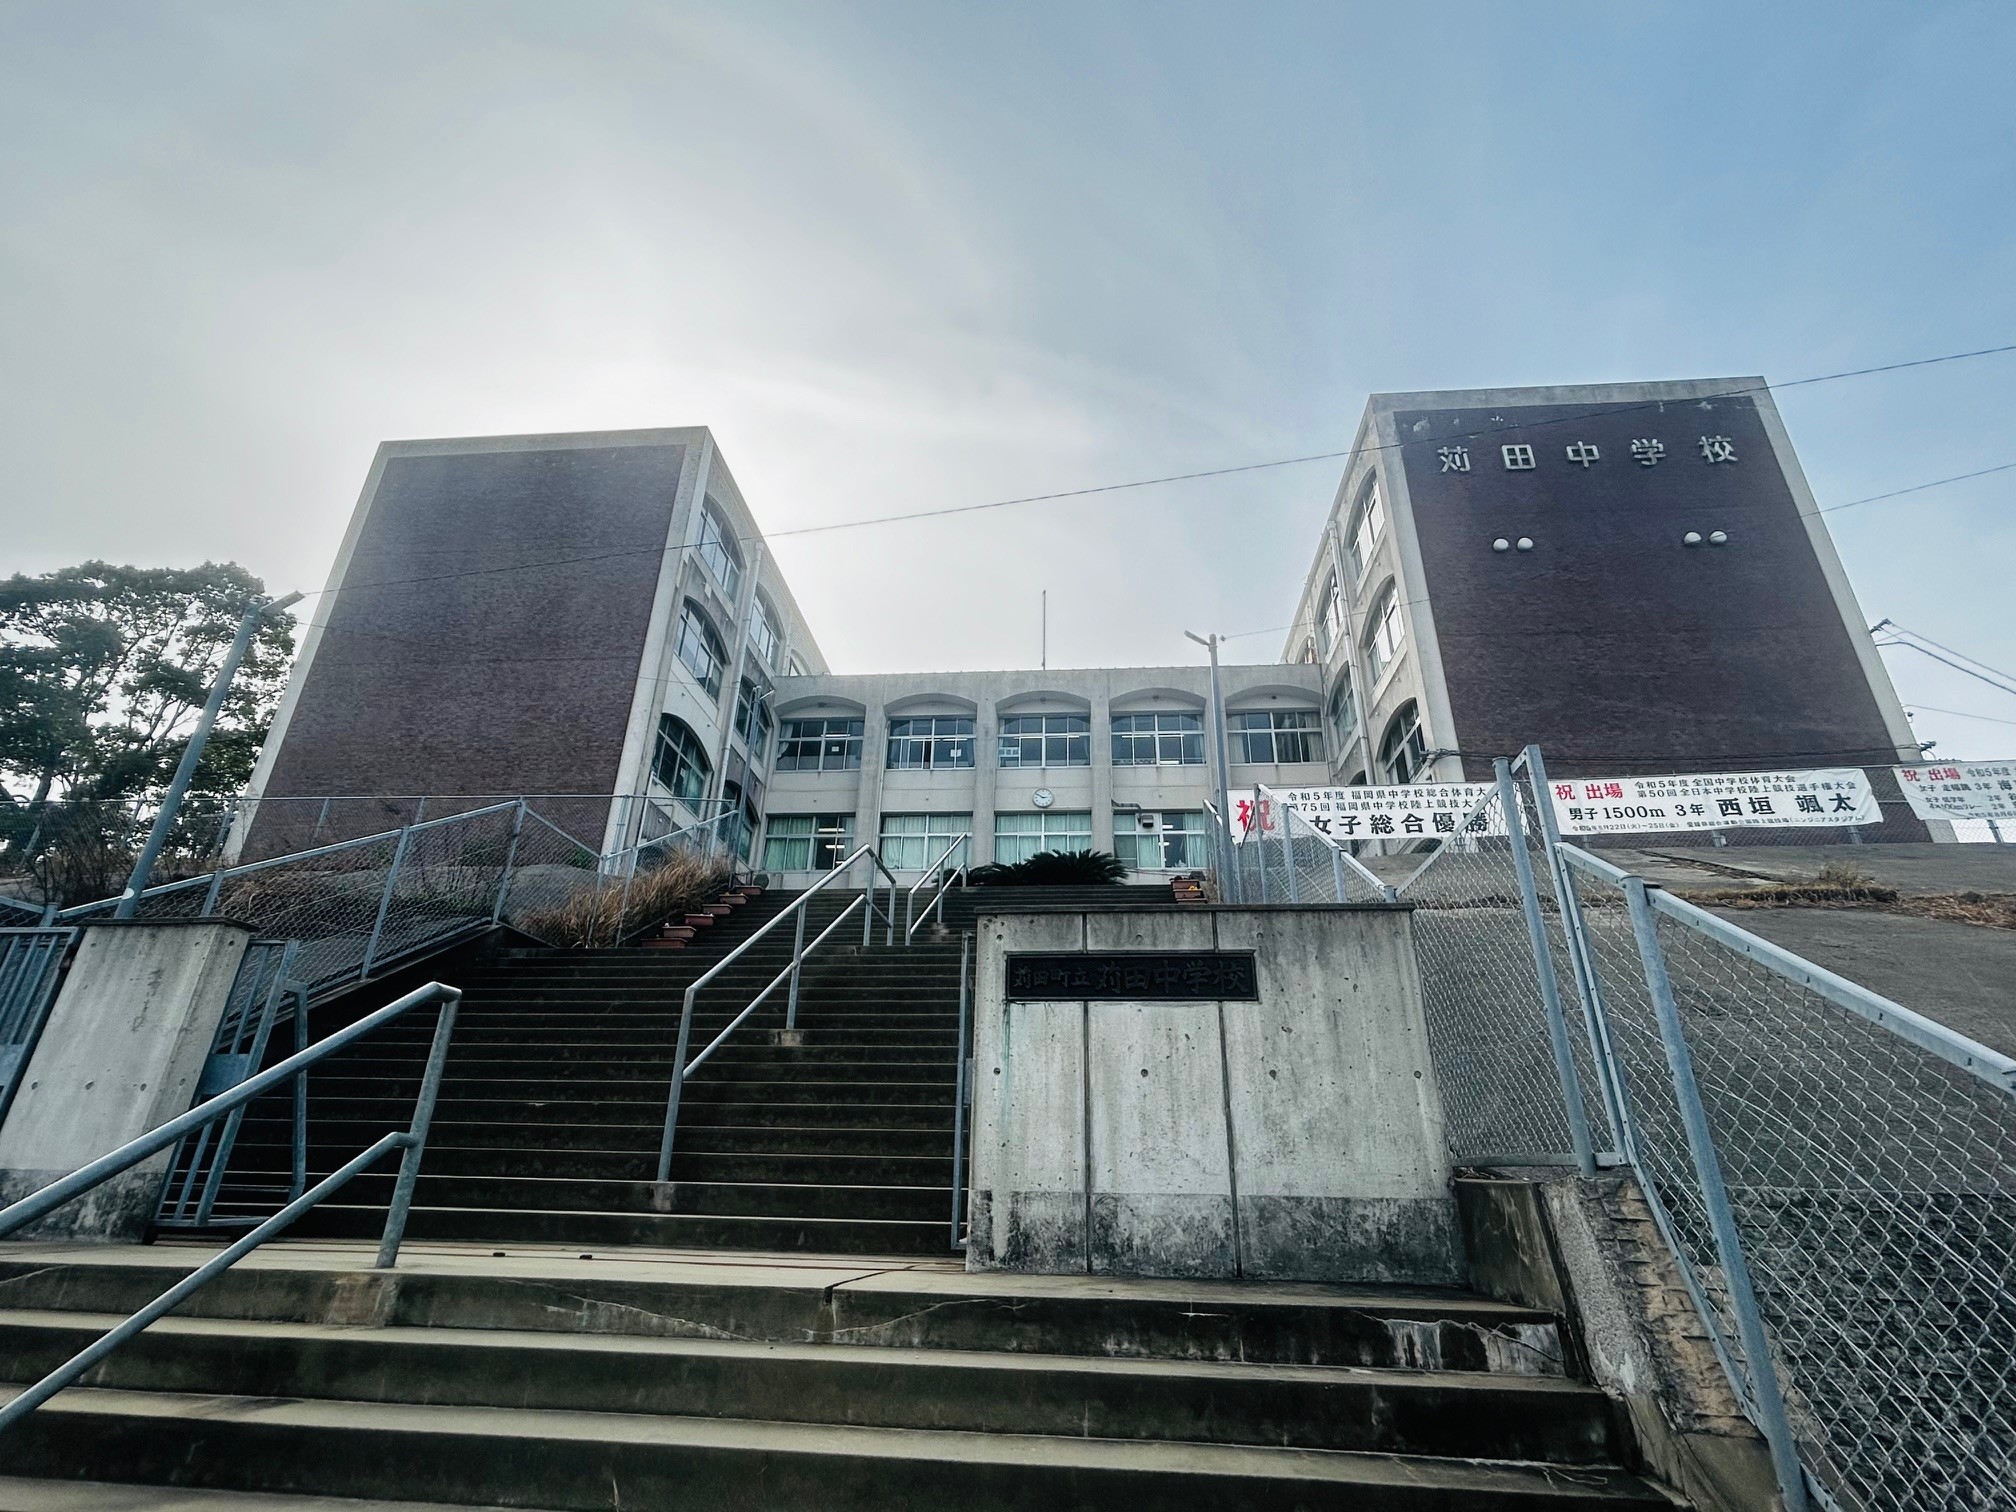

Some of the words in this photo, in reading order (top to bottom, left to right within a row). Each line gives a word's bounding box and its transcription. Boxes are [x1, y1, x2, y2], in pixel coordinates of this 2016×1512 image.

[1437, 434, 1738, 472] 苅田中学校
[1634, 778, 1689, 789] 令和5年度
[1692, 774, 1796, 788] 全国中学校体育大会
[1902, 769, 1920, 781] 祝
[1928, 767, 1960, 781] 出場
[1288, 790, 1345, 801] 令和5年度
[1351, 786, 1488, 800] 福岡県中学校総合体育大
[1555, 784, 1576, 800] 祝
[1585, 782, 1623, 800] 出場
[1636, 788, 1678, 798] 第50回
[1236, 800, 1275, 832] 祝
[1569, 807, 1598, 820] 男子
[1603, 805, 1666, 820] 1500m
[1674, 802, 1705, 818] 3年
[1716, 796, 1776, 817] 西垣
[1794, 792, 1857, 814] 颯太
[1309, 812, 1489, 835] 女子総合優勝
[1095, 960, 1250, 994] 苅田中学校
